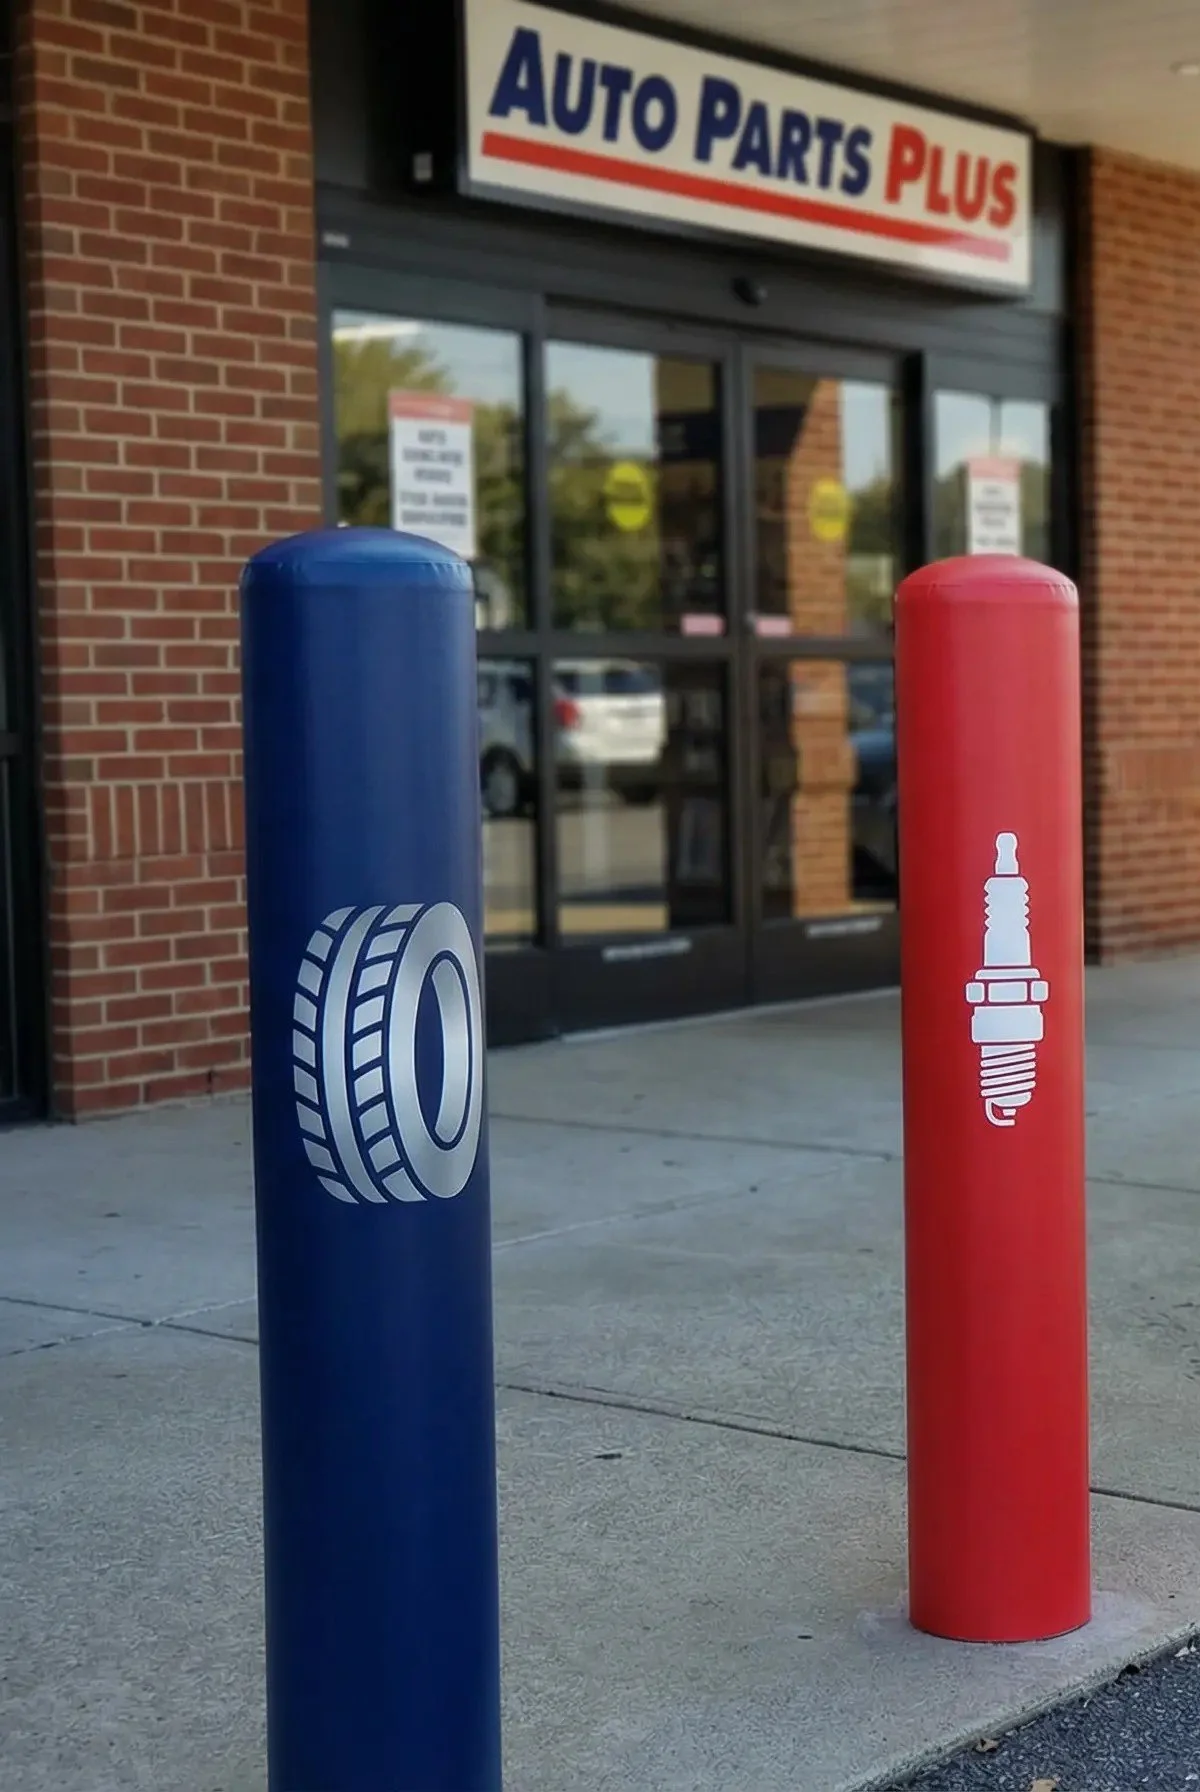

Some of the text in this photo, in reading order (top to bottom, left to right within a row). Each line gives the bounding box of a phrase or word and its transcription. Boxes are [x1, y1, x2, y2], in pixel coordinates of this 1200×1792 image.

[489, 27, 1017, 228] AUTO PARTS PLUS
